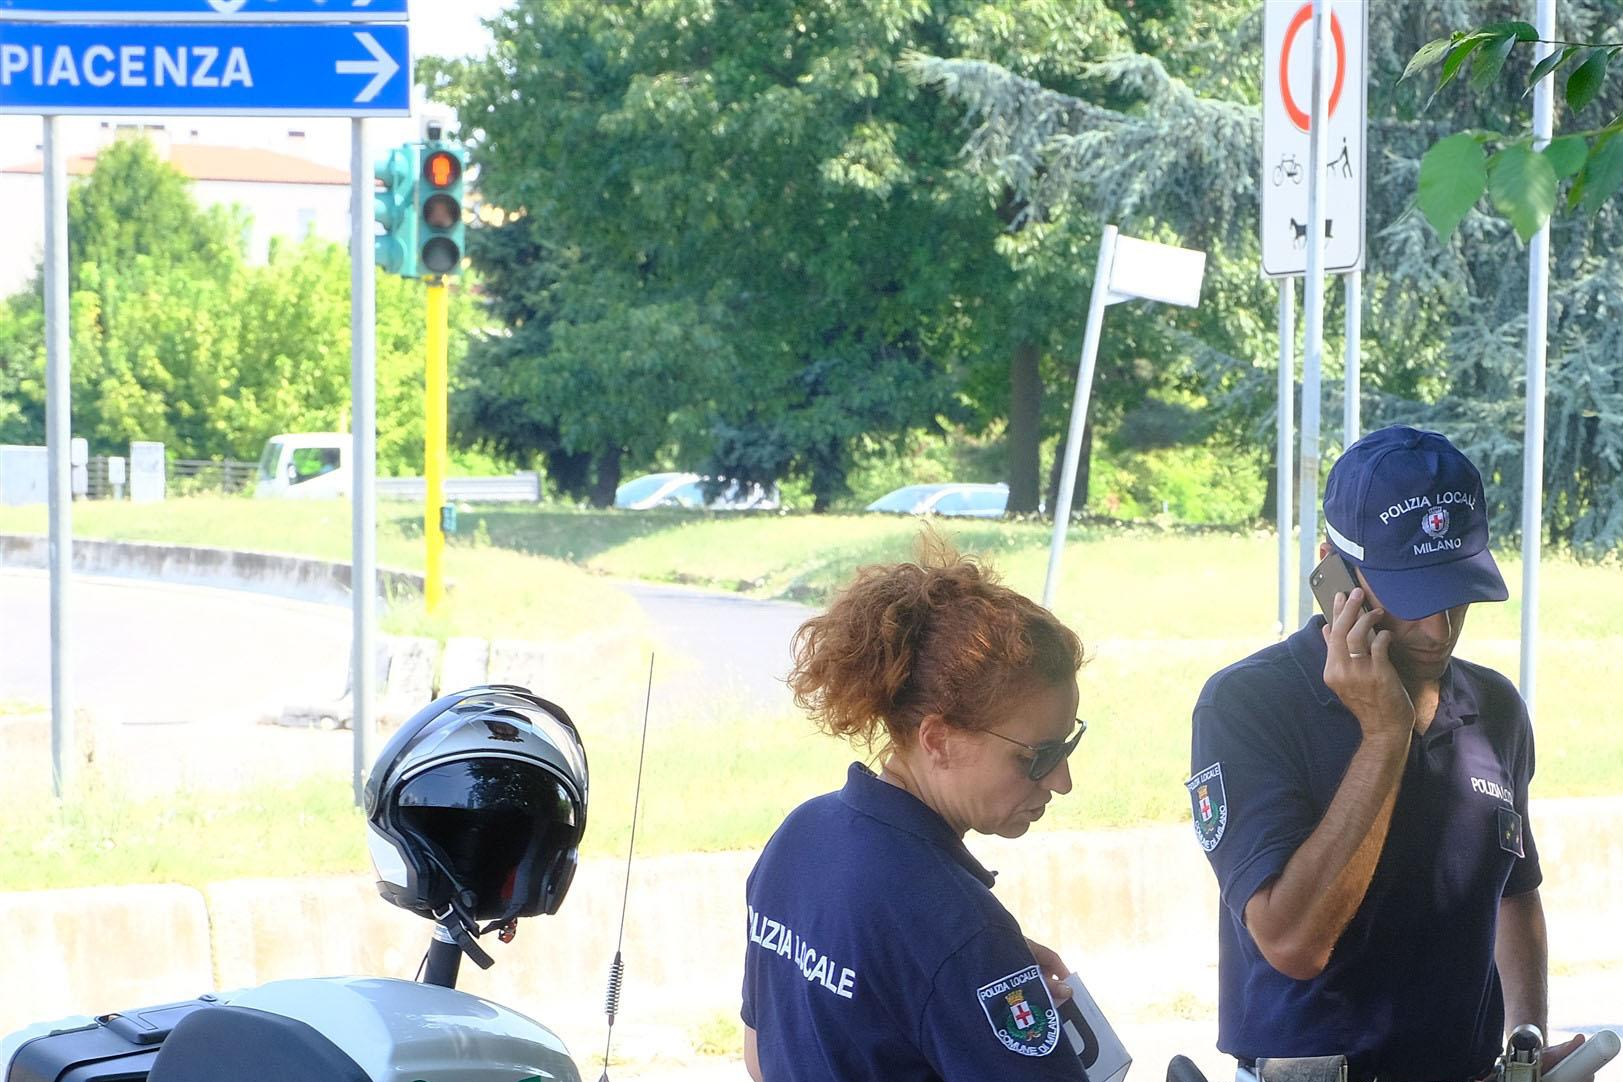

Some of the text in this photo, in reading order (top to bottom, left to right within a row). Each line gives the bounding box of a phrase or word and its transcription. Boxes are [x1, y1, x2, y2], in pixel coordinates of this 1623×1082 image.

[1, 44, 254, 88] PIACENZA
[1380, 496, 1431, 525] POLIZIA
[1413, 538, 1461, 555] MILANO
[980, 968, 1039, 1001] POLIZIA LOCALE
[998, 1008, 1058, 1056] COMUNE DI MILANO
